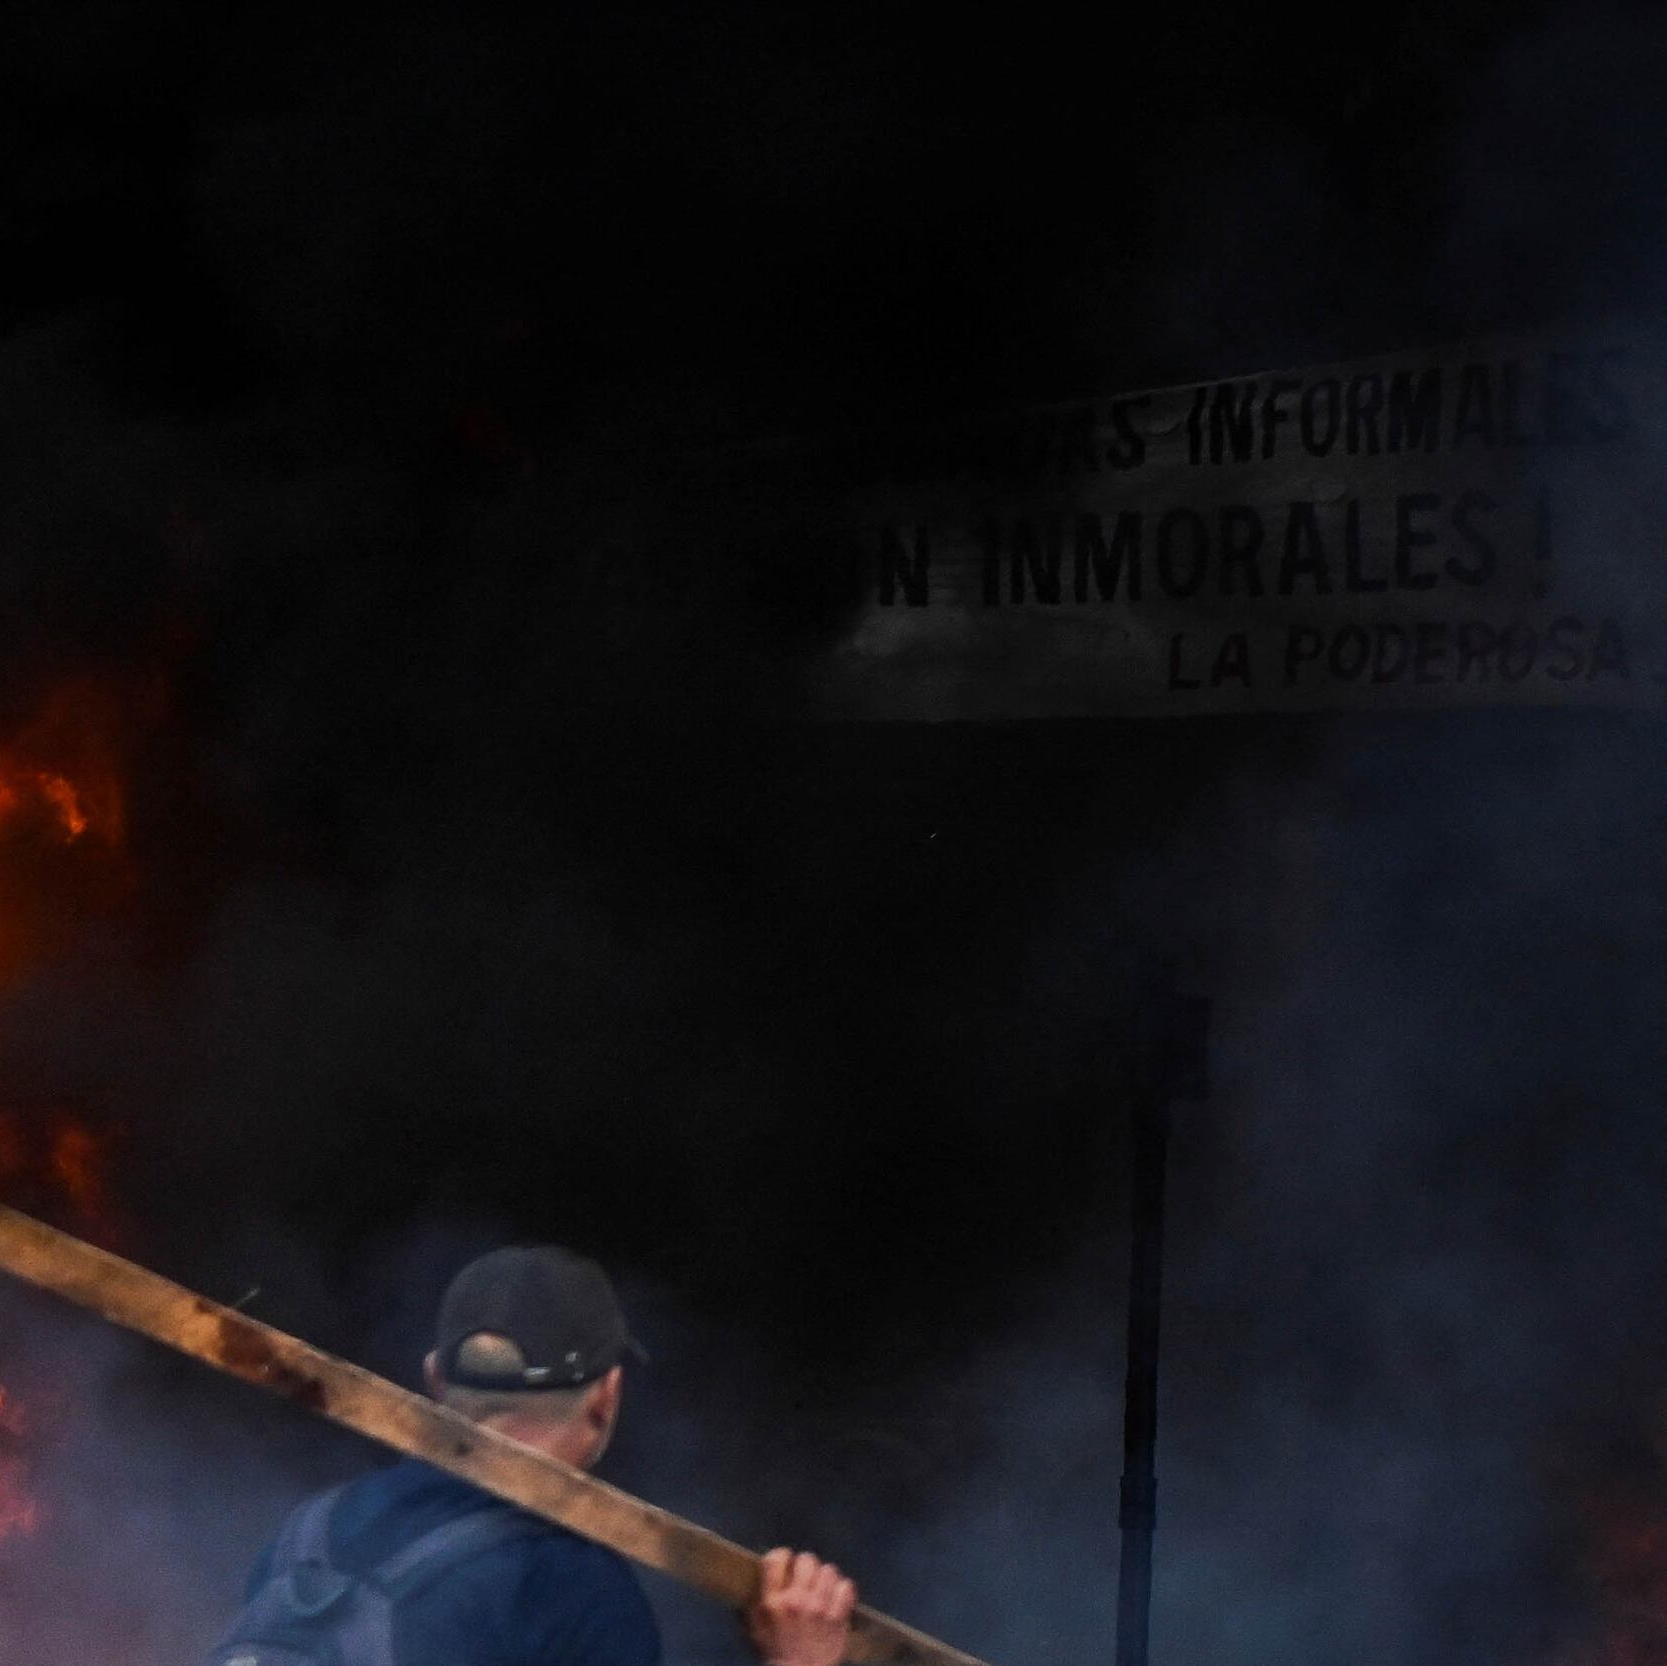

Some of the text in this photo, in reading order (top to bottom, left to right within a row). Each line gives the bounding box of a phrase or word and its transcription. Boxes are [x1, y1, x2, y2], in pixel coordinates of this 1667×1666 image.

[1186, 348, 1630, 466] INFORMALES
[1167, 615, 1630, 690] LA PODEROSA
